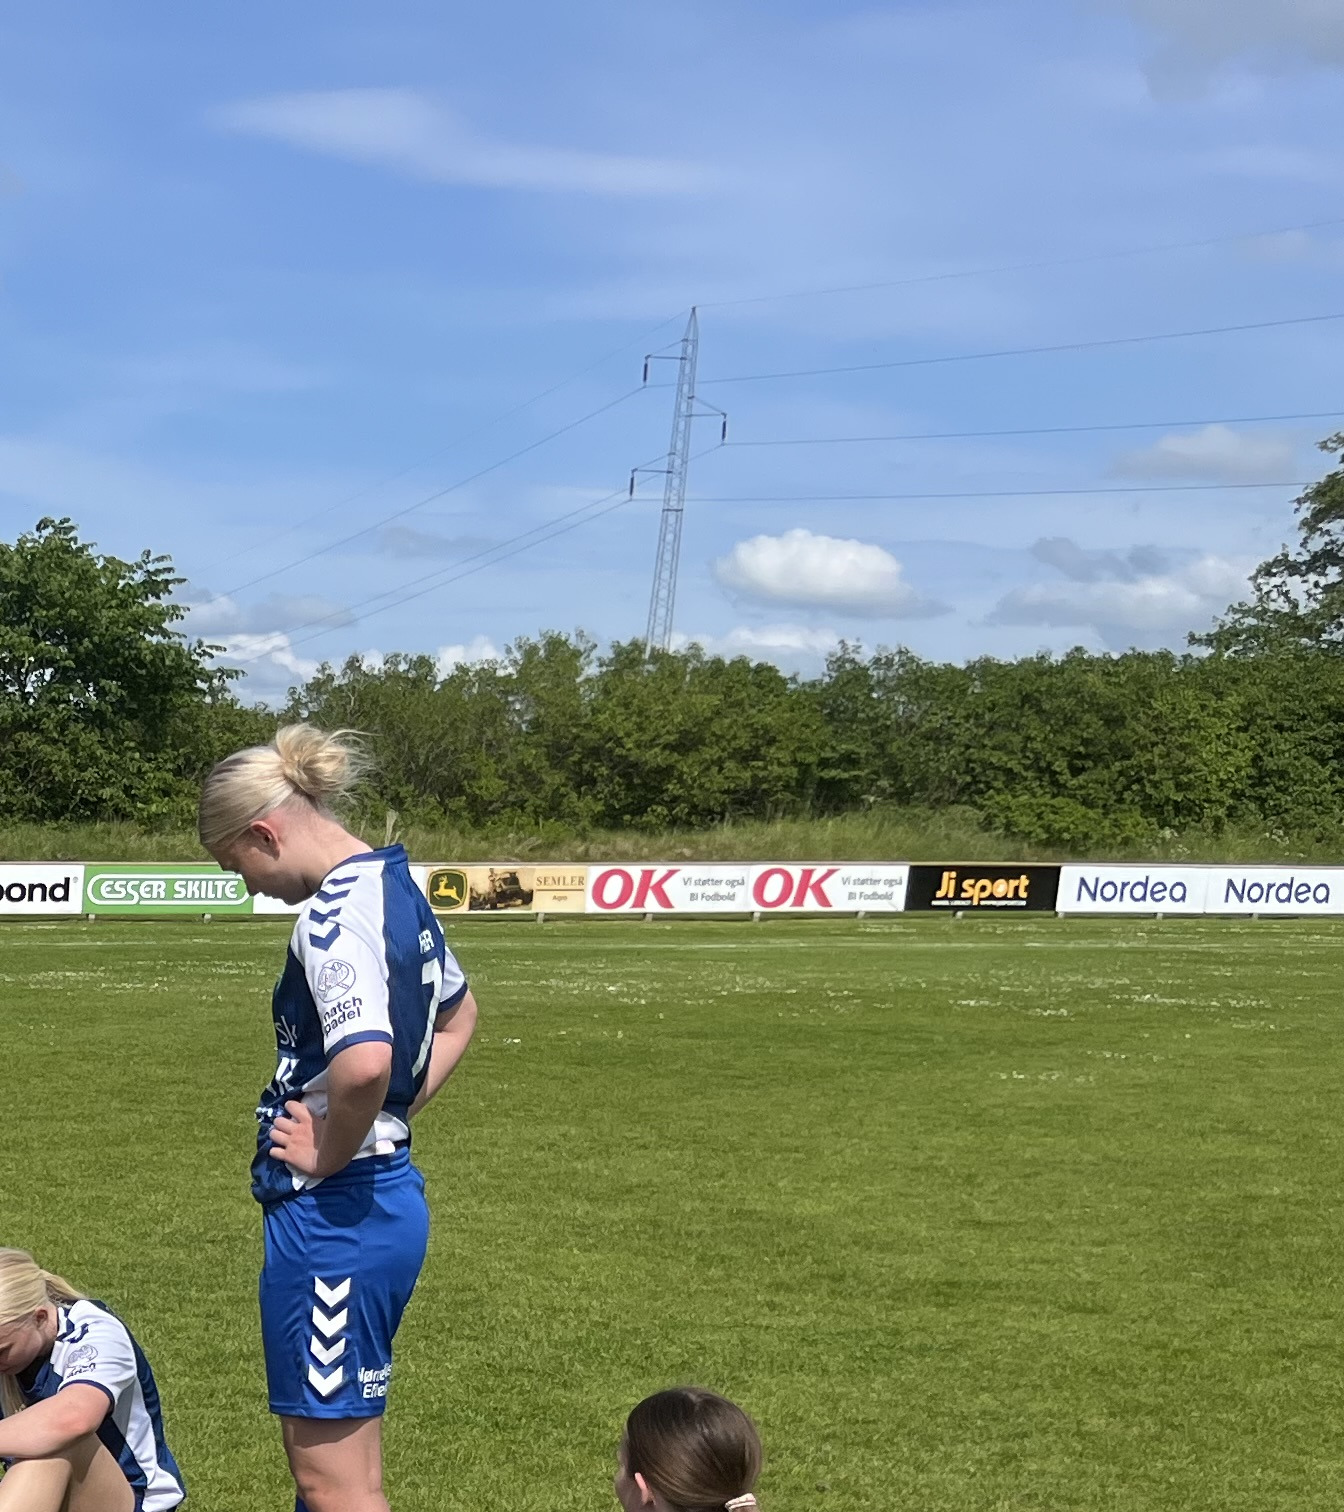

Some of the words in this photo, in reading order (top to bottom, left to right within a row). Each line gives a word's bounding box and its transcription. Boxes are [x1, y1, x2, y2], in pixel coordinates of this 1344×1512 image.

[172, 879, 239, 900] SKILTE
[535, 875, 585, 887] SEMLER
[591, 868, 682, 909] OK
[682, 877, 693, 887] Vi
[694, 877, 723, 887] støtter
[725, 876, 746, 889] også
[752, 867, 841, 908] OK
[841, 877, 852, 887] Vi
[853, 877, 881, 887] støtter
[883, 876, 903, 889] også
[935, 870, 957, 899] Ji
[960, 873, 1031, 906] sport
[1076, 875, 1187, 904] Nordea
[1224, 877, 1331, 905] Nordea
[701, 891, 736, 902] Fodbold
[859, 891, 894, 902] Fodbold
